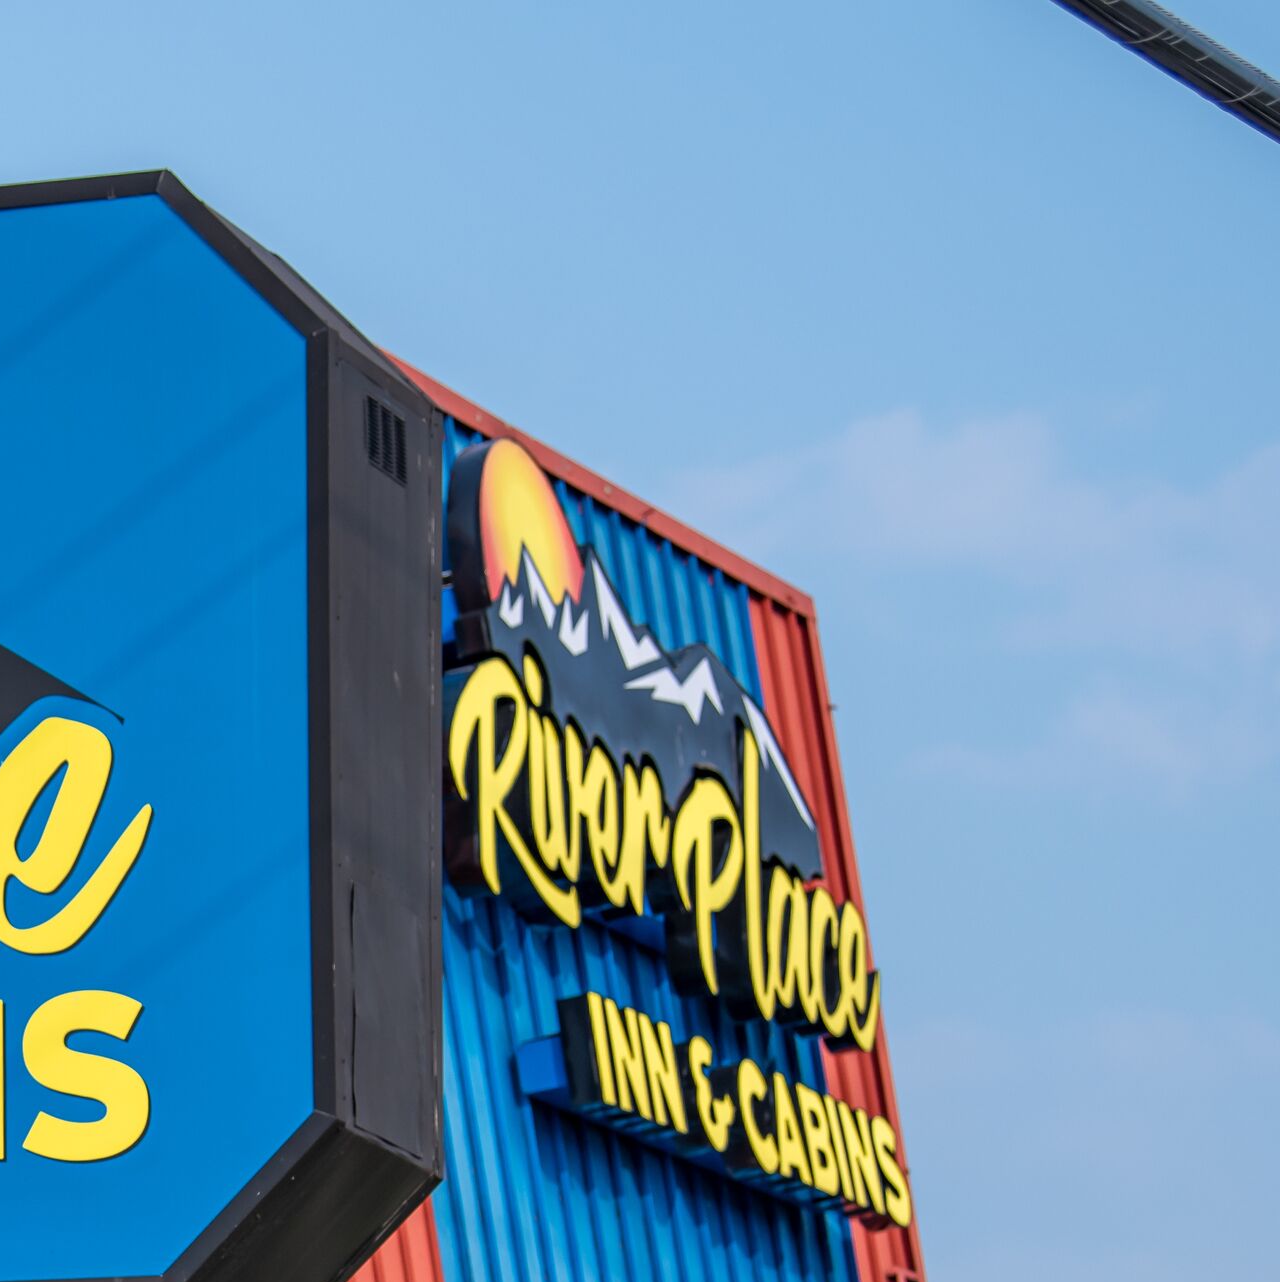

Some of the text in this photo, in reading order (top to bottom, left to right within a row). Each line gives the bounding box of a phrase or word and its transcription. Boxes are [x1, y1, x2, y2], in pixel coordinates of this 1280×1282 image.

[587, 991, 911, 1228] INN & CABINS
